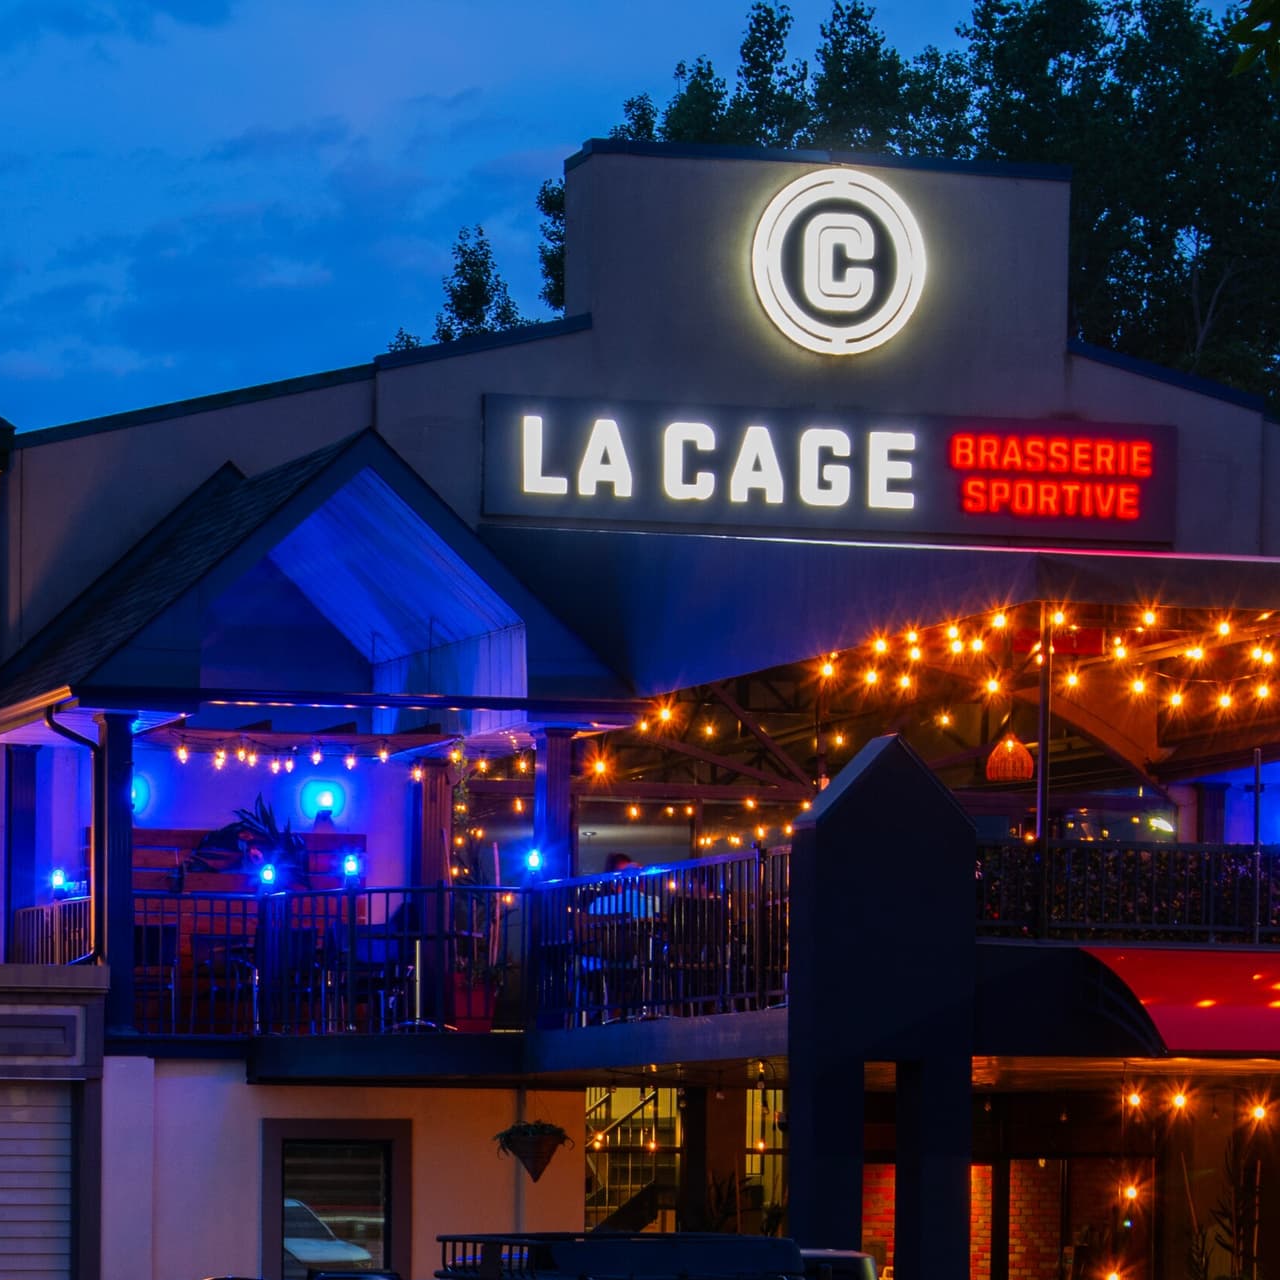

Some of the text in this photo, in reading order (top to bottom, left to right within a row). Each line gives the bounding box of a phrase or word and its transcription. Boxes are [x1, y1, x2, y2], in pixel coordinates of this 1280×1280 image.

[522, 415, 917, 510] LA CAGE
[950, 432, 1153, 478] BRASSERIE
[962, 477, 1140, 520] SPORTIVE
